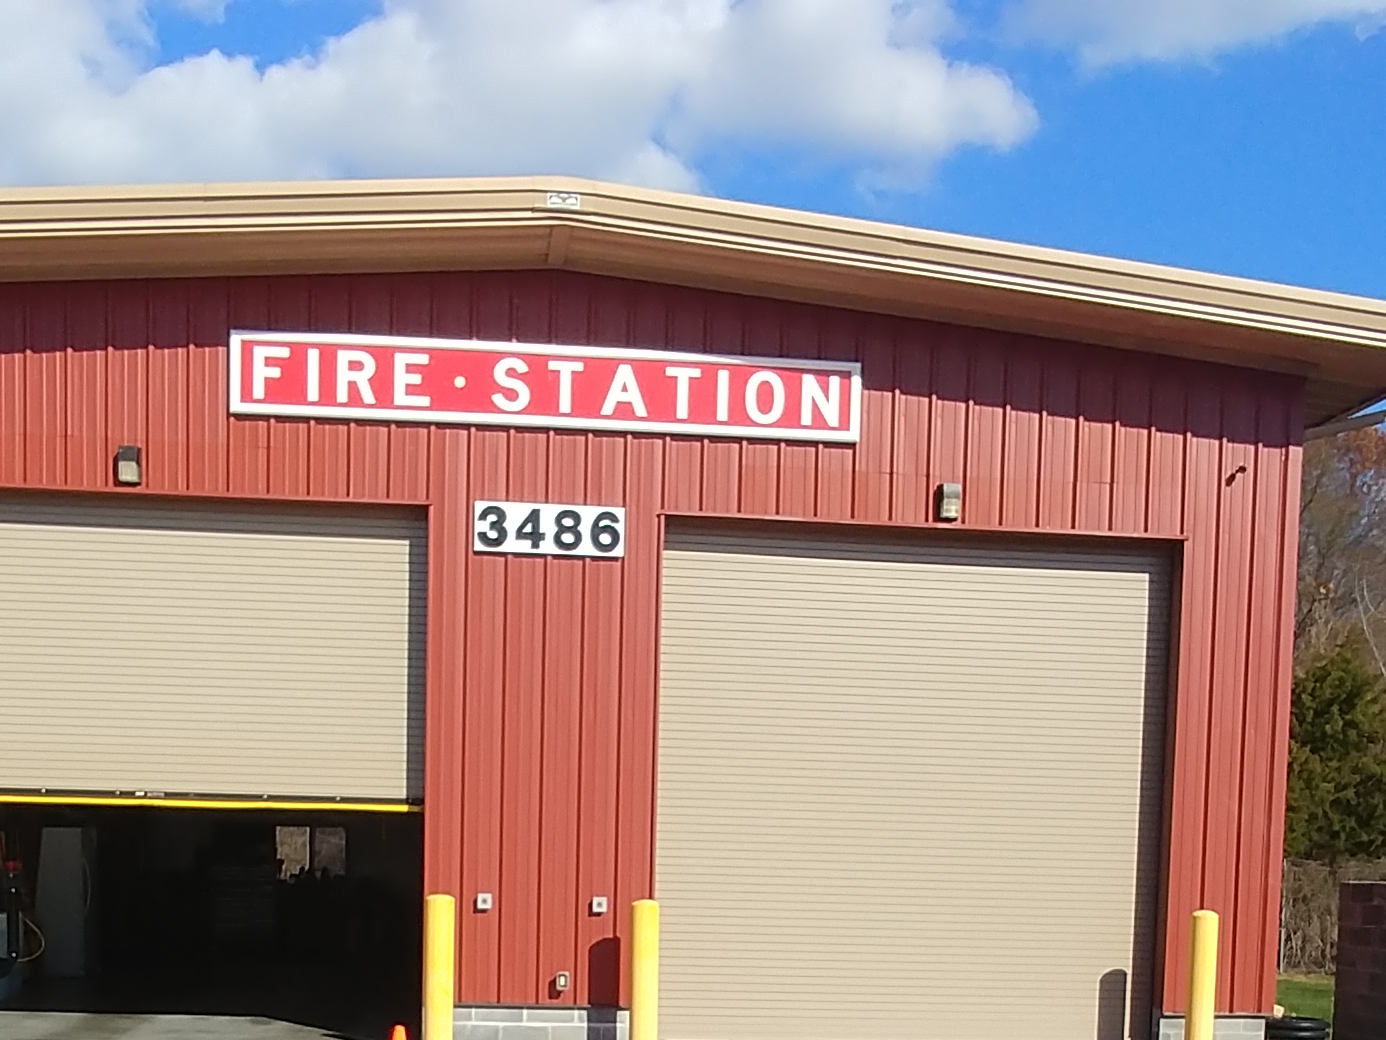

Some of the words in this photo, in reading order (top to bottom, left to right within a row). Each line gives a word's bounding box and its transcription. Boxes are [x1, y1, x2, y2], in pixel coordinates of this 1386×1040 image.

[251, 346, 431, 407] FIRE
[491, 357, 844, 428] STATION
[476, 505, 622, 552] 3486
